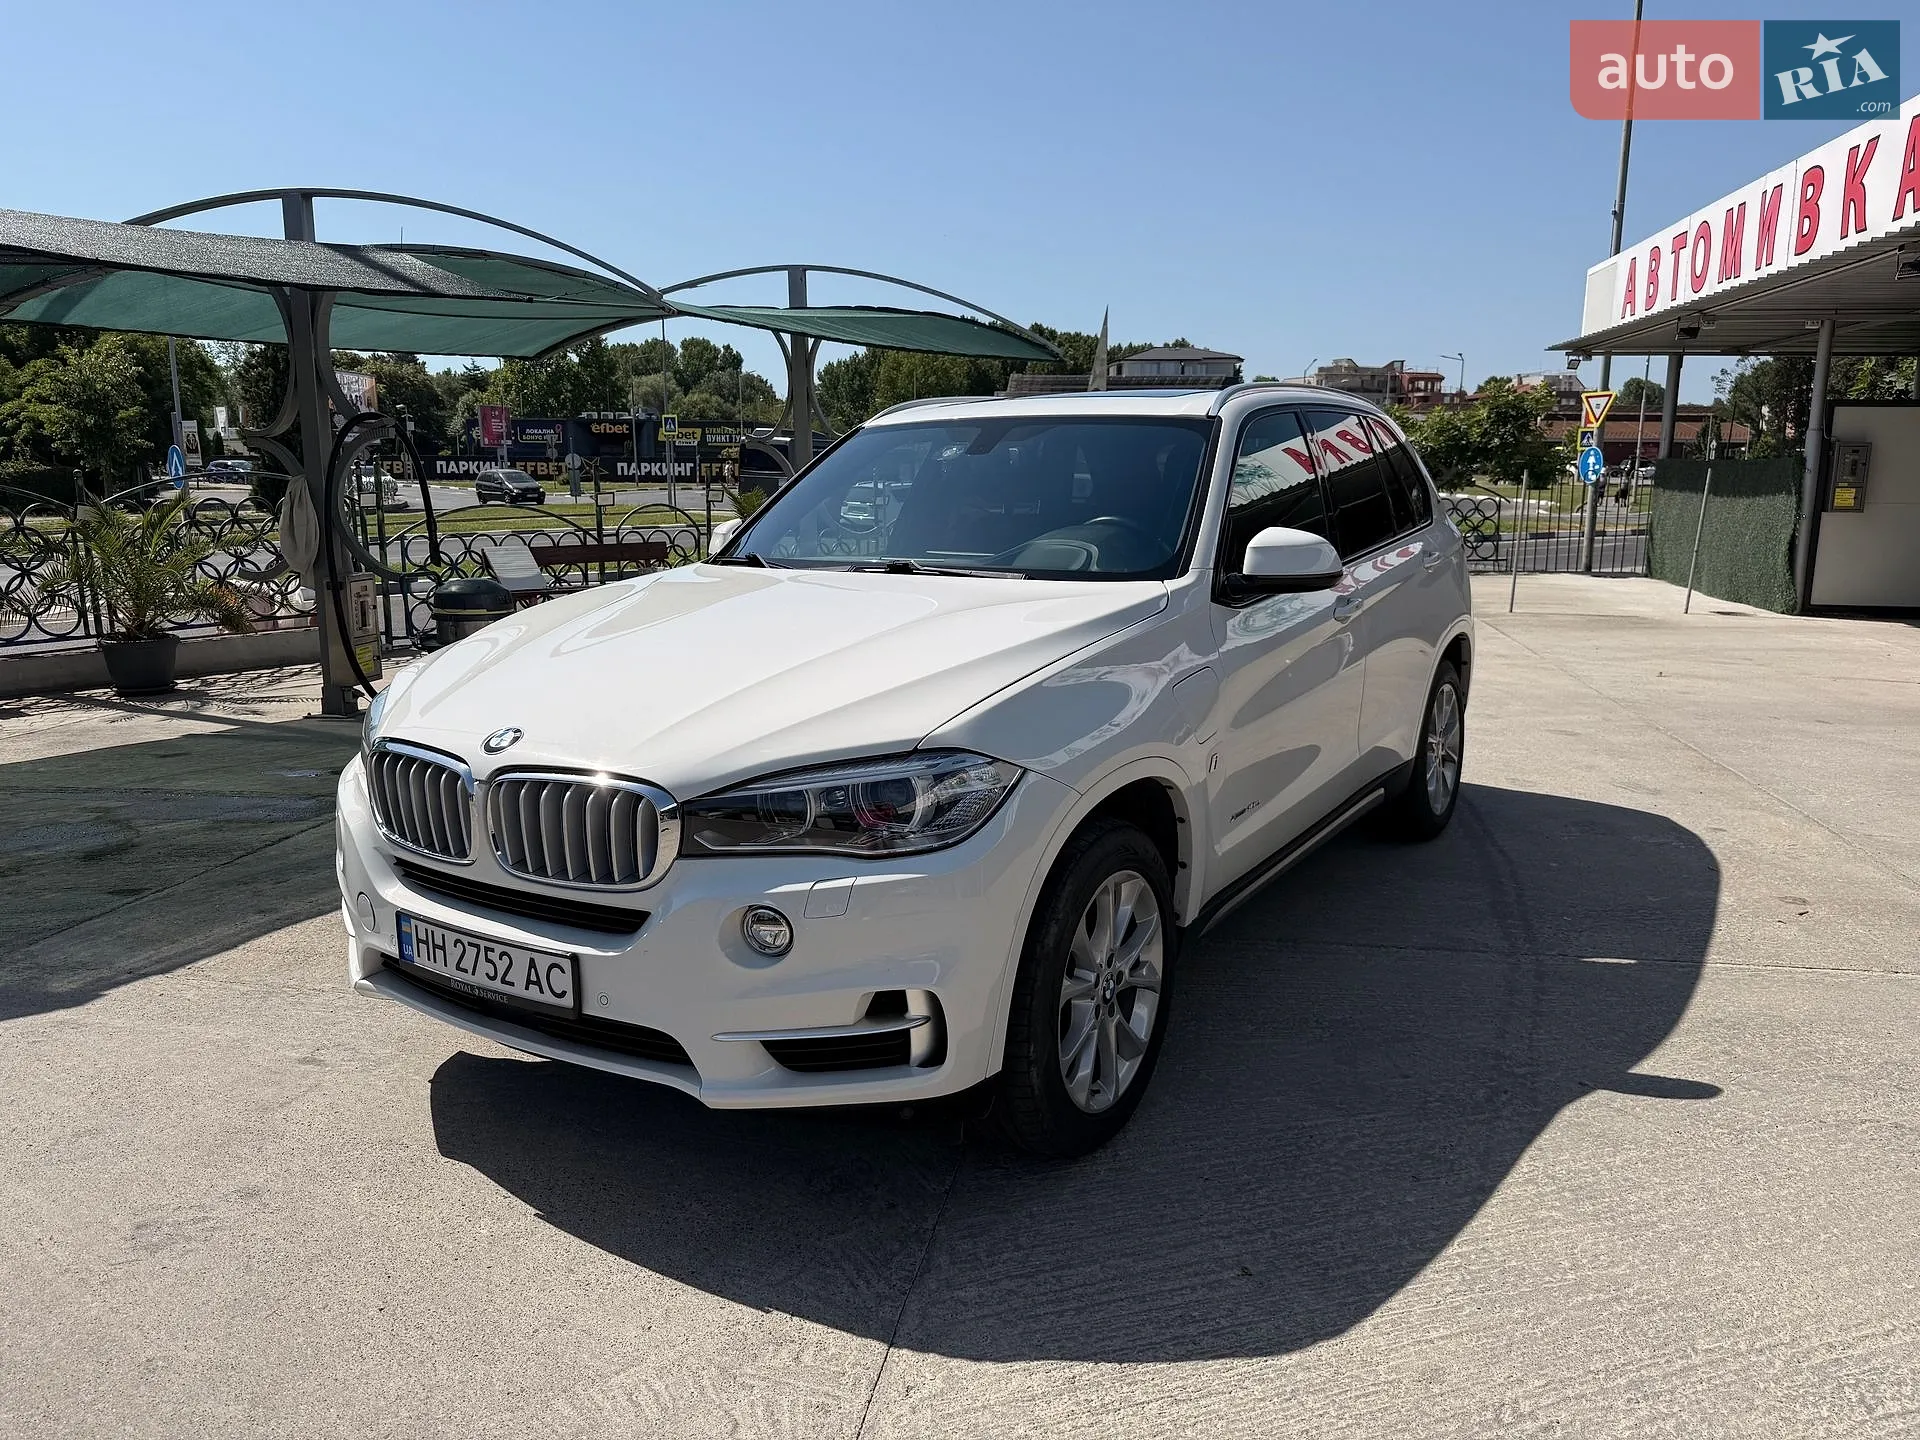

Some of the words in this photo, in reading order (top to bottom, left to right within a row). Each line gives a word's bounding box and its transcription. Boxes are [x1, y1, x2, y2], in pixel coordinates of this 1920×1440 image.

[590, 422, 630, 434] efbet
[706, 434, 730, 443] ПУНКТ
[617, 462, 694, 476] ПАРКИНГ
[403, 944, 414, 956] UA
[453, 938, 515, 987] 2752
[524, 956, 568, 999] AC
[451, 980, 473, 994] ROYAL
[479, 990, 509, 1004] SERVICE
